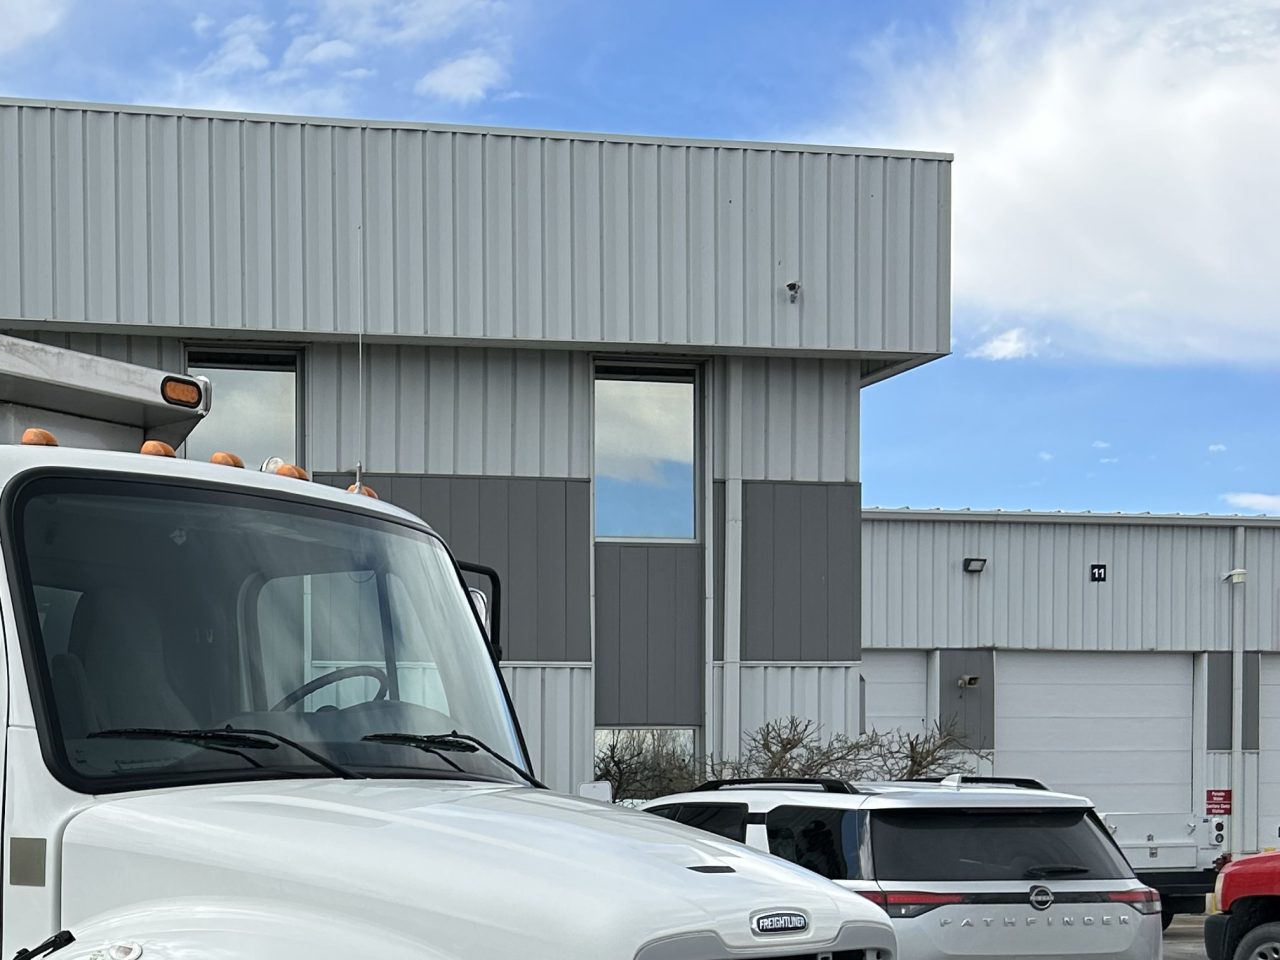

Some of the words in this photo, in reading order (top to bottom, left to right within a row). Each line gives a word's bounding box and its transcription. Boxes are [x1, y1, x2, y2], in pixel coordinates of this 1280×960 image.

[1093, 569, 1104, 578] 11
[759, 916, 805, 929] FREIGHTLINER
[940, 916, 1129, 928] PATHFINDER
